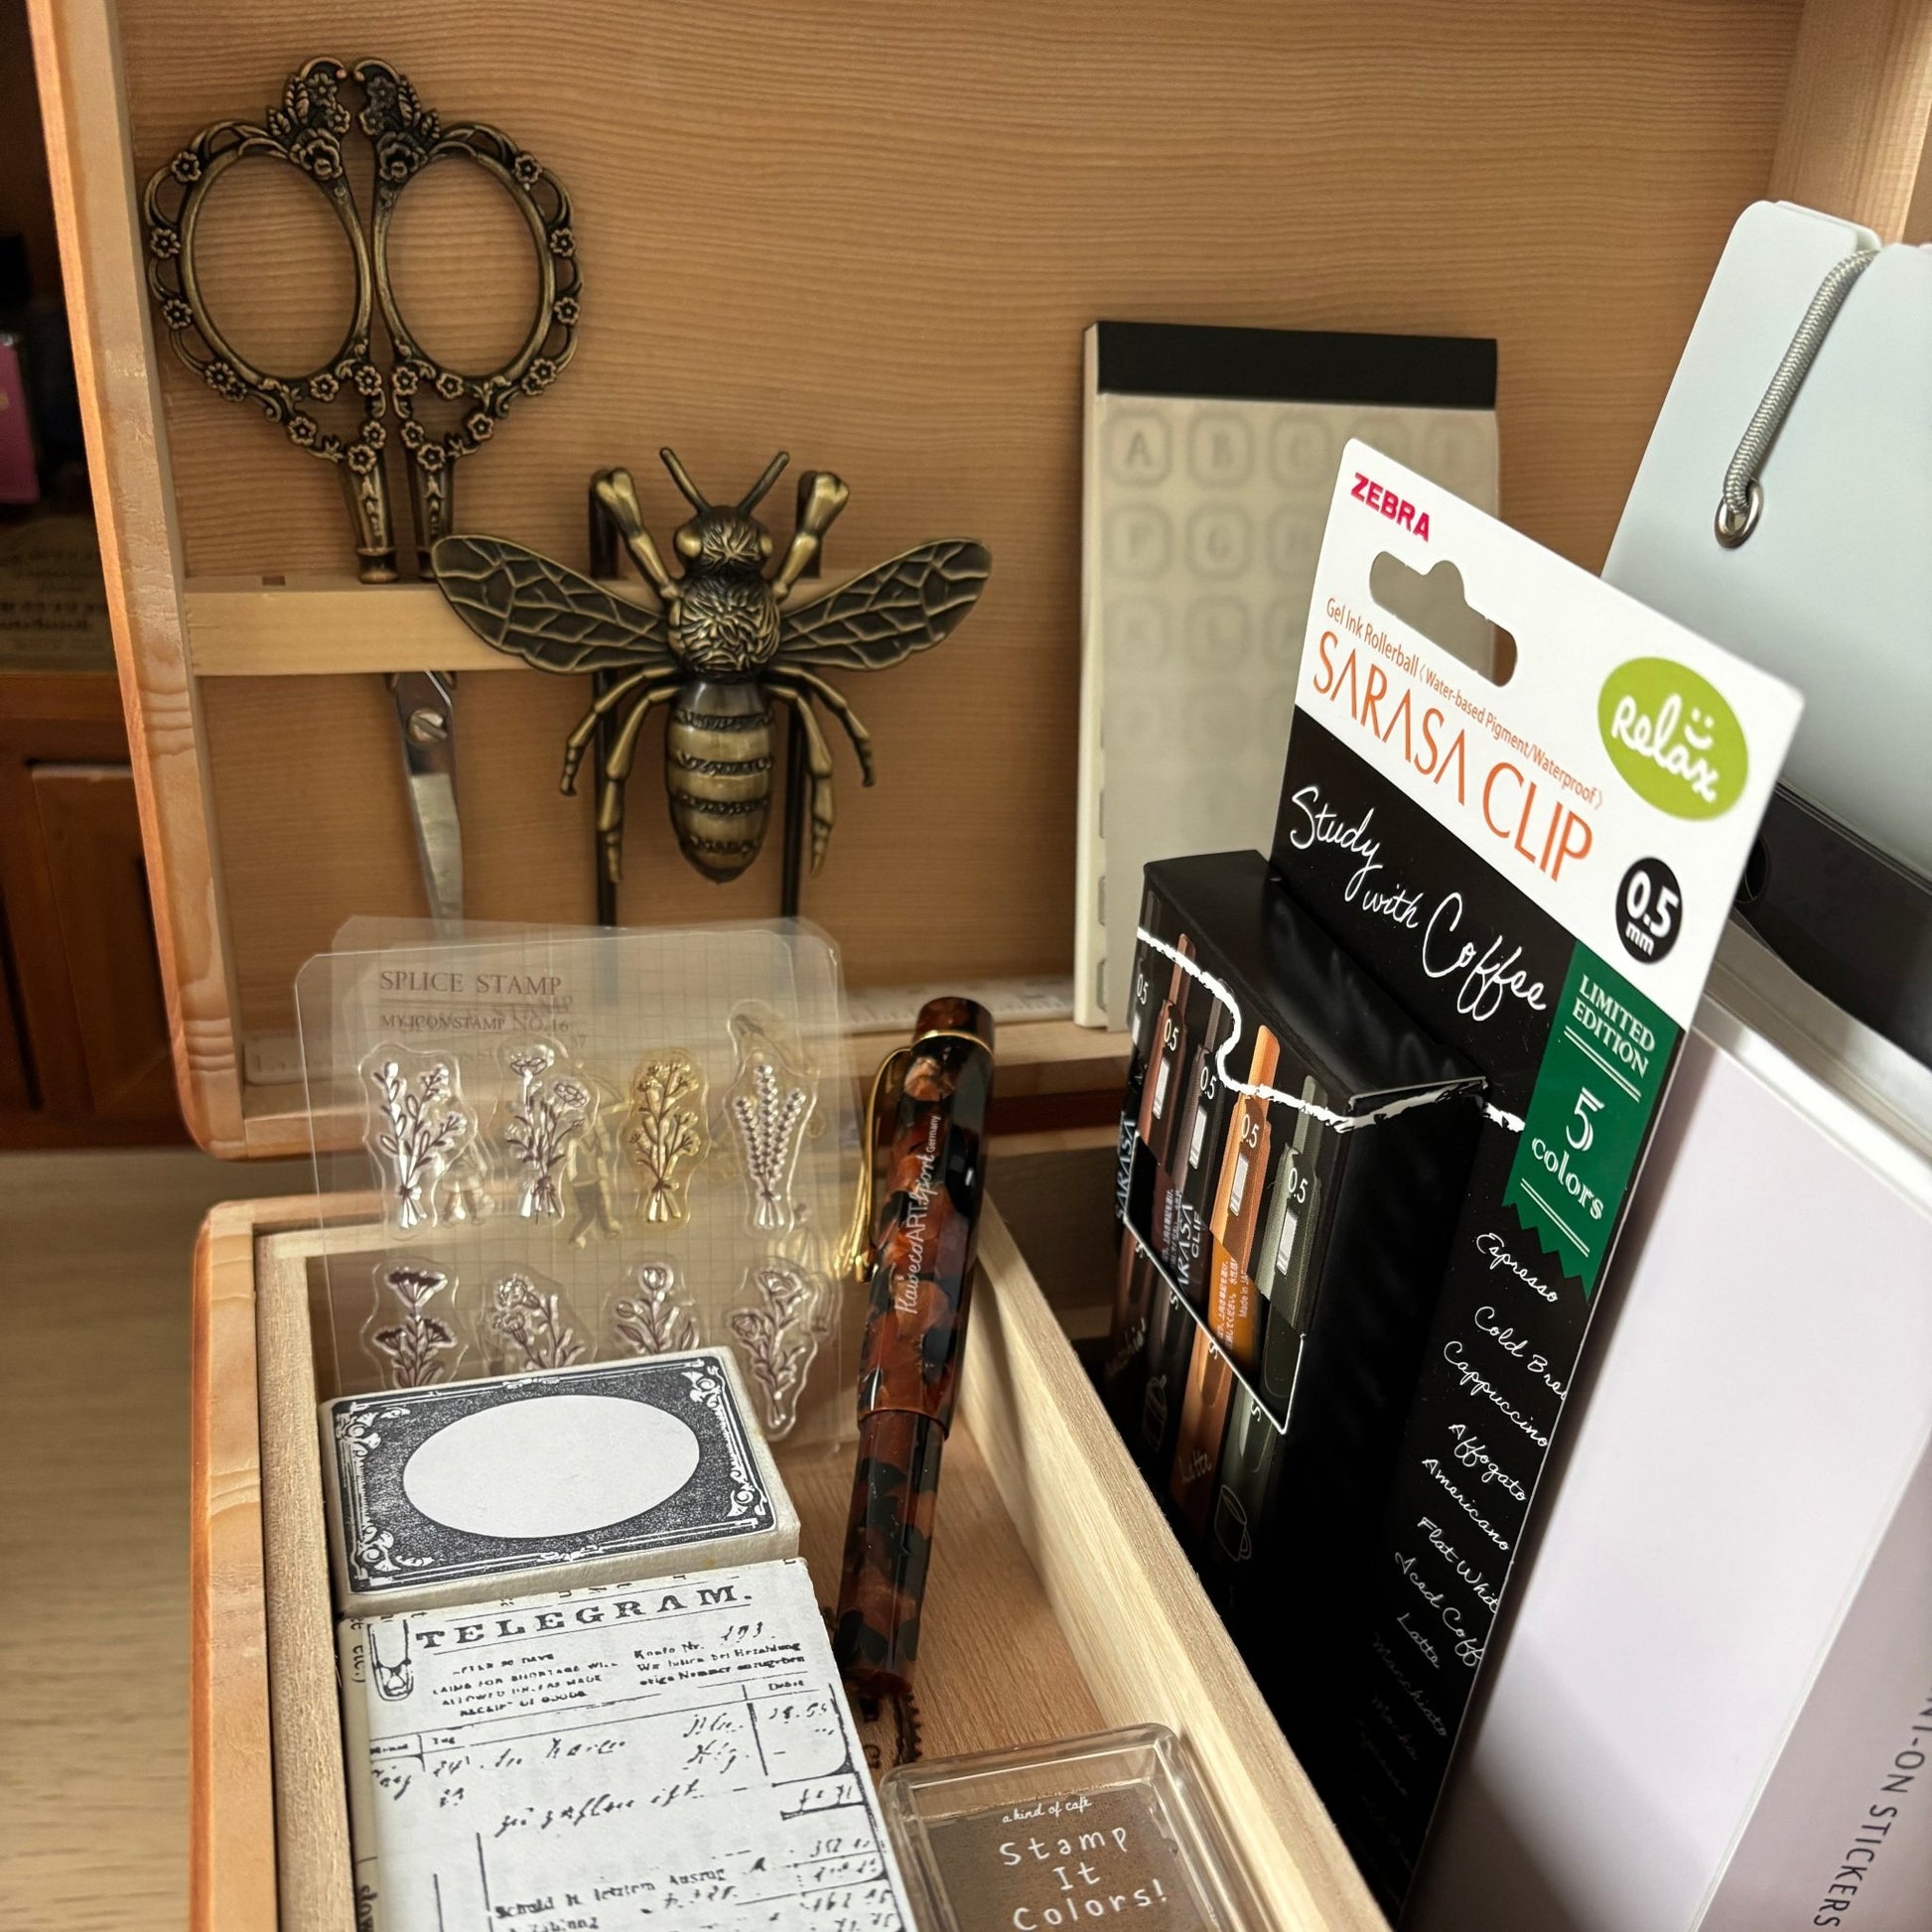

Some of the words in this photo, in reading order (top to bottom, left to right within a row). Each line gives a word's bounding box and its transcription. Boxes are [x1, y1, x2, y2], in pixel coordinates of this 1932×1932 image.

[1351, 472, 1430, 542] ZEBRA
[1326, 598, 1345, 623] Gel
[1346, 610, 1363, 636] Ink
[1365, 625, 1420, 678] Rollerball
[1312, 630, 1465, 806] SARASA
[1482, 761, 1593, 882] CLIP
[1610, 692, 1720, 803] Relax
[1290, 786, 1383, 901] Study
[1362, 884, 1424, 928] with
[1423, 893, 1546, 1021] Coffee
[1626, 871, 1679, 938] 0.5
[1625, 921, 1655, 957] mm
[380, 970, 464, 993] SPLICE
[477, 974, 562, 996] STAMP
[1580, 974, 1655, 1052] LIMITED
[1164, 1019, 1178, 1051] 0.5
[1573, 998, 1649, 1078] EDITION
[1200, 1066, 1216, 1099] 0.5
[926, 1115, 941, 1153] Germany
[1242, 1114, 1259, 1148] 0.5
[1566, 1087, 1604, 1152] 5
[1289, 1168, 1308, 1203] 0.5
[1532, 1138, 1603, 1220] colors
[1240, 1286, 1248, 1295] in
[1476, 1232, 1558, 1303] Espresso
[1239, 1296, 1248, 1317] Made
[1474, 1307, 1528, 1357] Cold
[1444, 1341, 1548, 1448] Cappuccino
[1449, 1424, 1526, 1501] Affogato
[1422, 1458, 1510, 1551] Americano
[1417, 1516, 1459, 1563] Flat
[416, 1586, 752, 1649] TELEGRAM.
[1397, 1612, 1440, 1669] Latte
[1371, 1630, 1448, 1737] Macchiato
[1014, 1803, 1045, 1821] kind
[1048, 1801, 1062, 1818] of
[999, 1827, 1128, 1866] Stamp
[1052, 1862, 1101, 1891] It
[1814, 1804, 1898, 1927] STICKERS
[1013, 1878, 1168, 1931] Colors!
